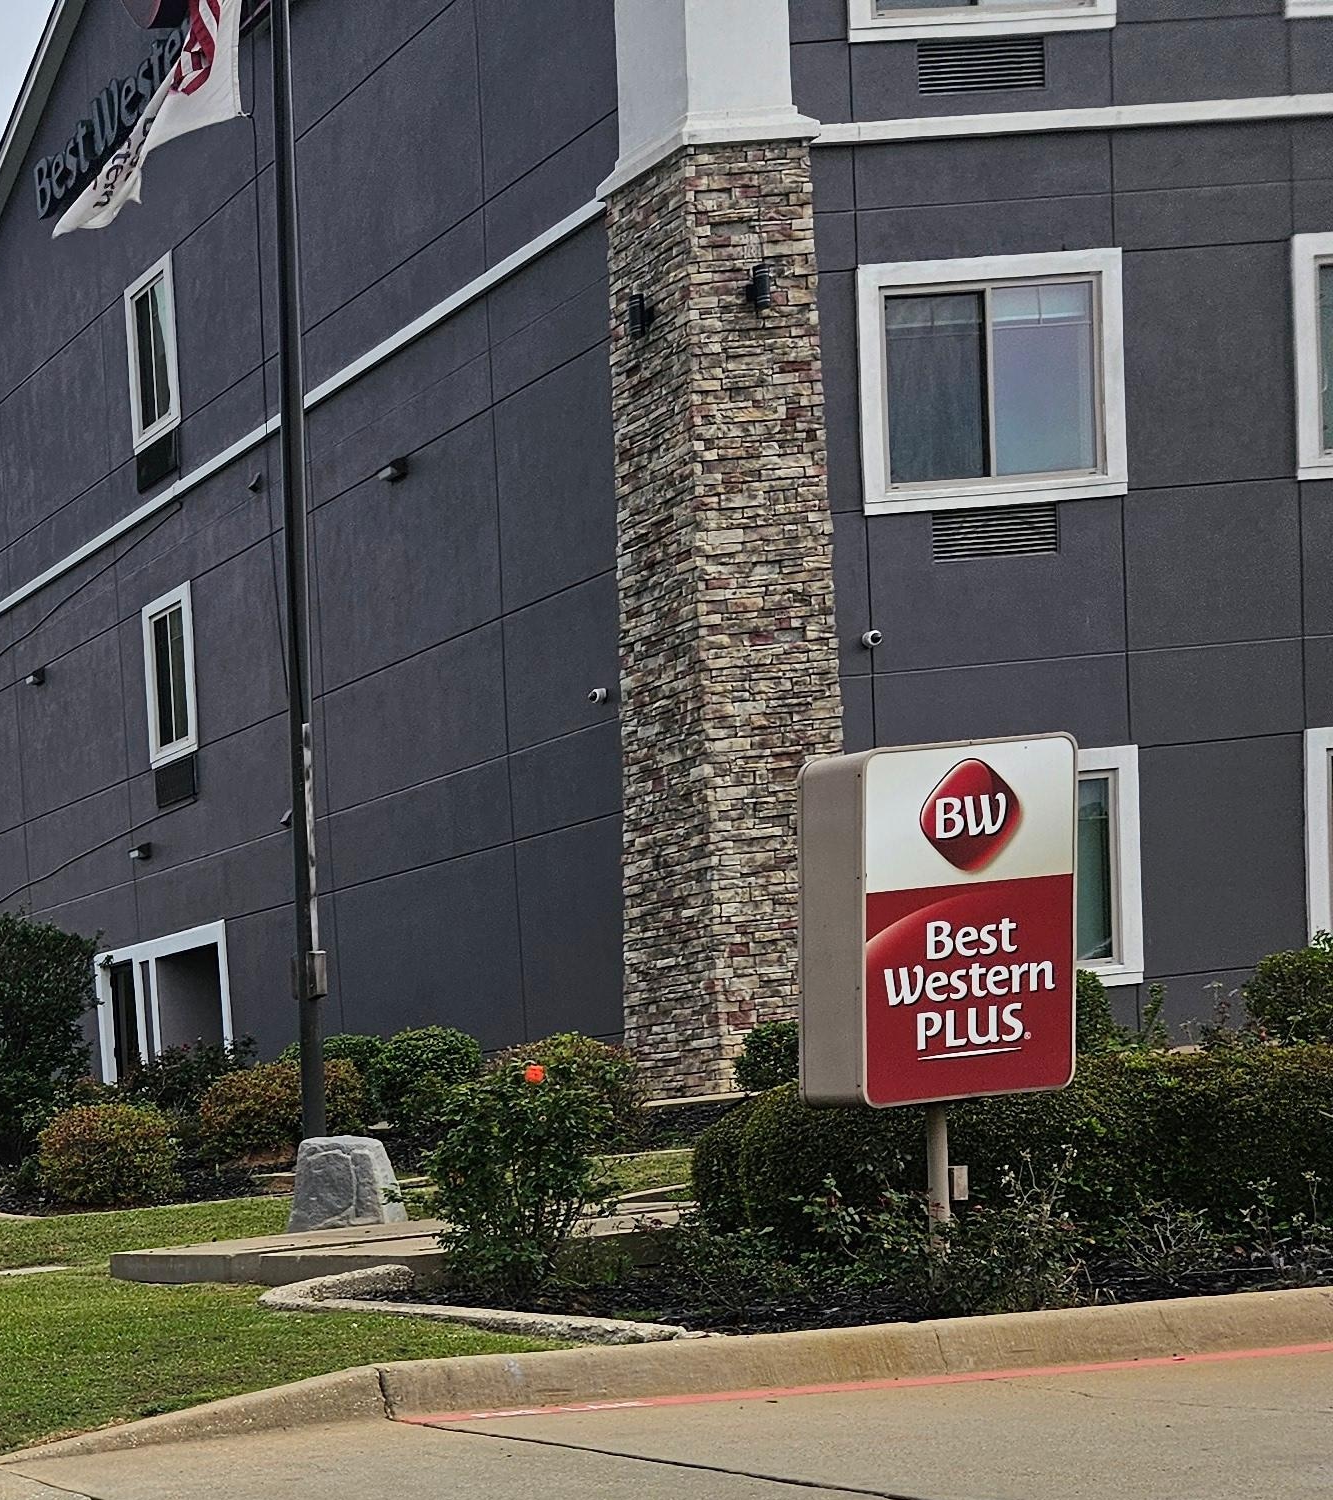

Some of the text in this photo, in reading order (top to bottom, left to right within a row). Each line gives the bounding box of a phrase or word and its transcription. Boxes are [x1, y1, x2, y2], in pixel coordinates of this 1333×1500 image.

[34, 119, 90, 219] Best
[935, 792, 1007, 840] BW
[925, 917, 1018, 960] Best
[883, 959, 1055, 1007] Western
[916, 1002, 1024, 1051] PLUS
